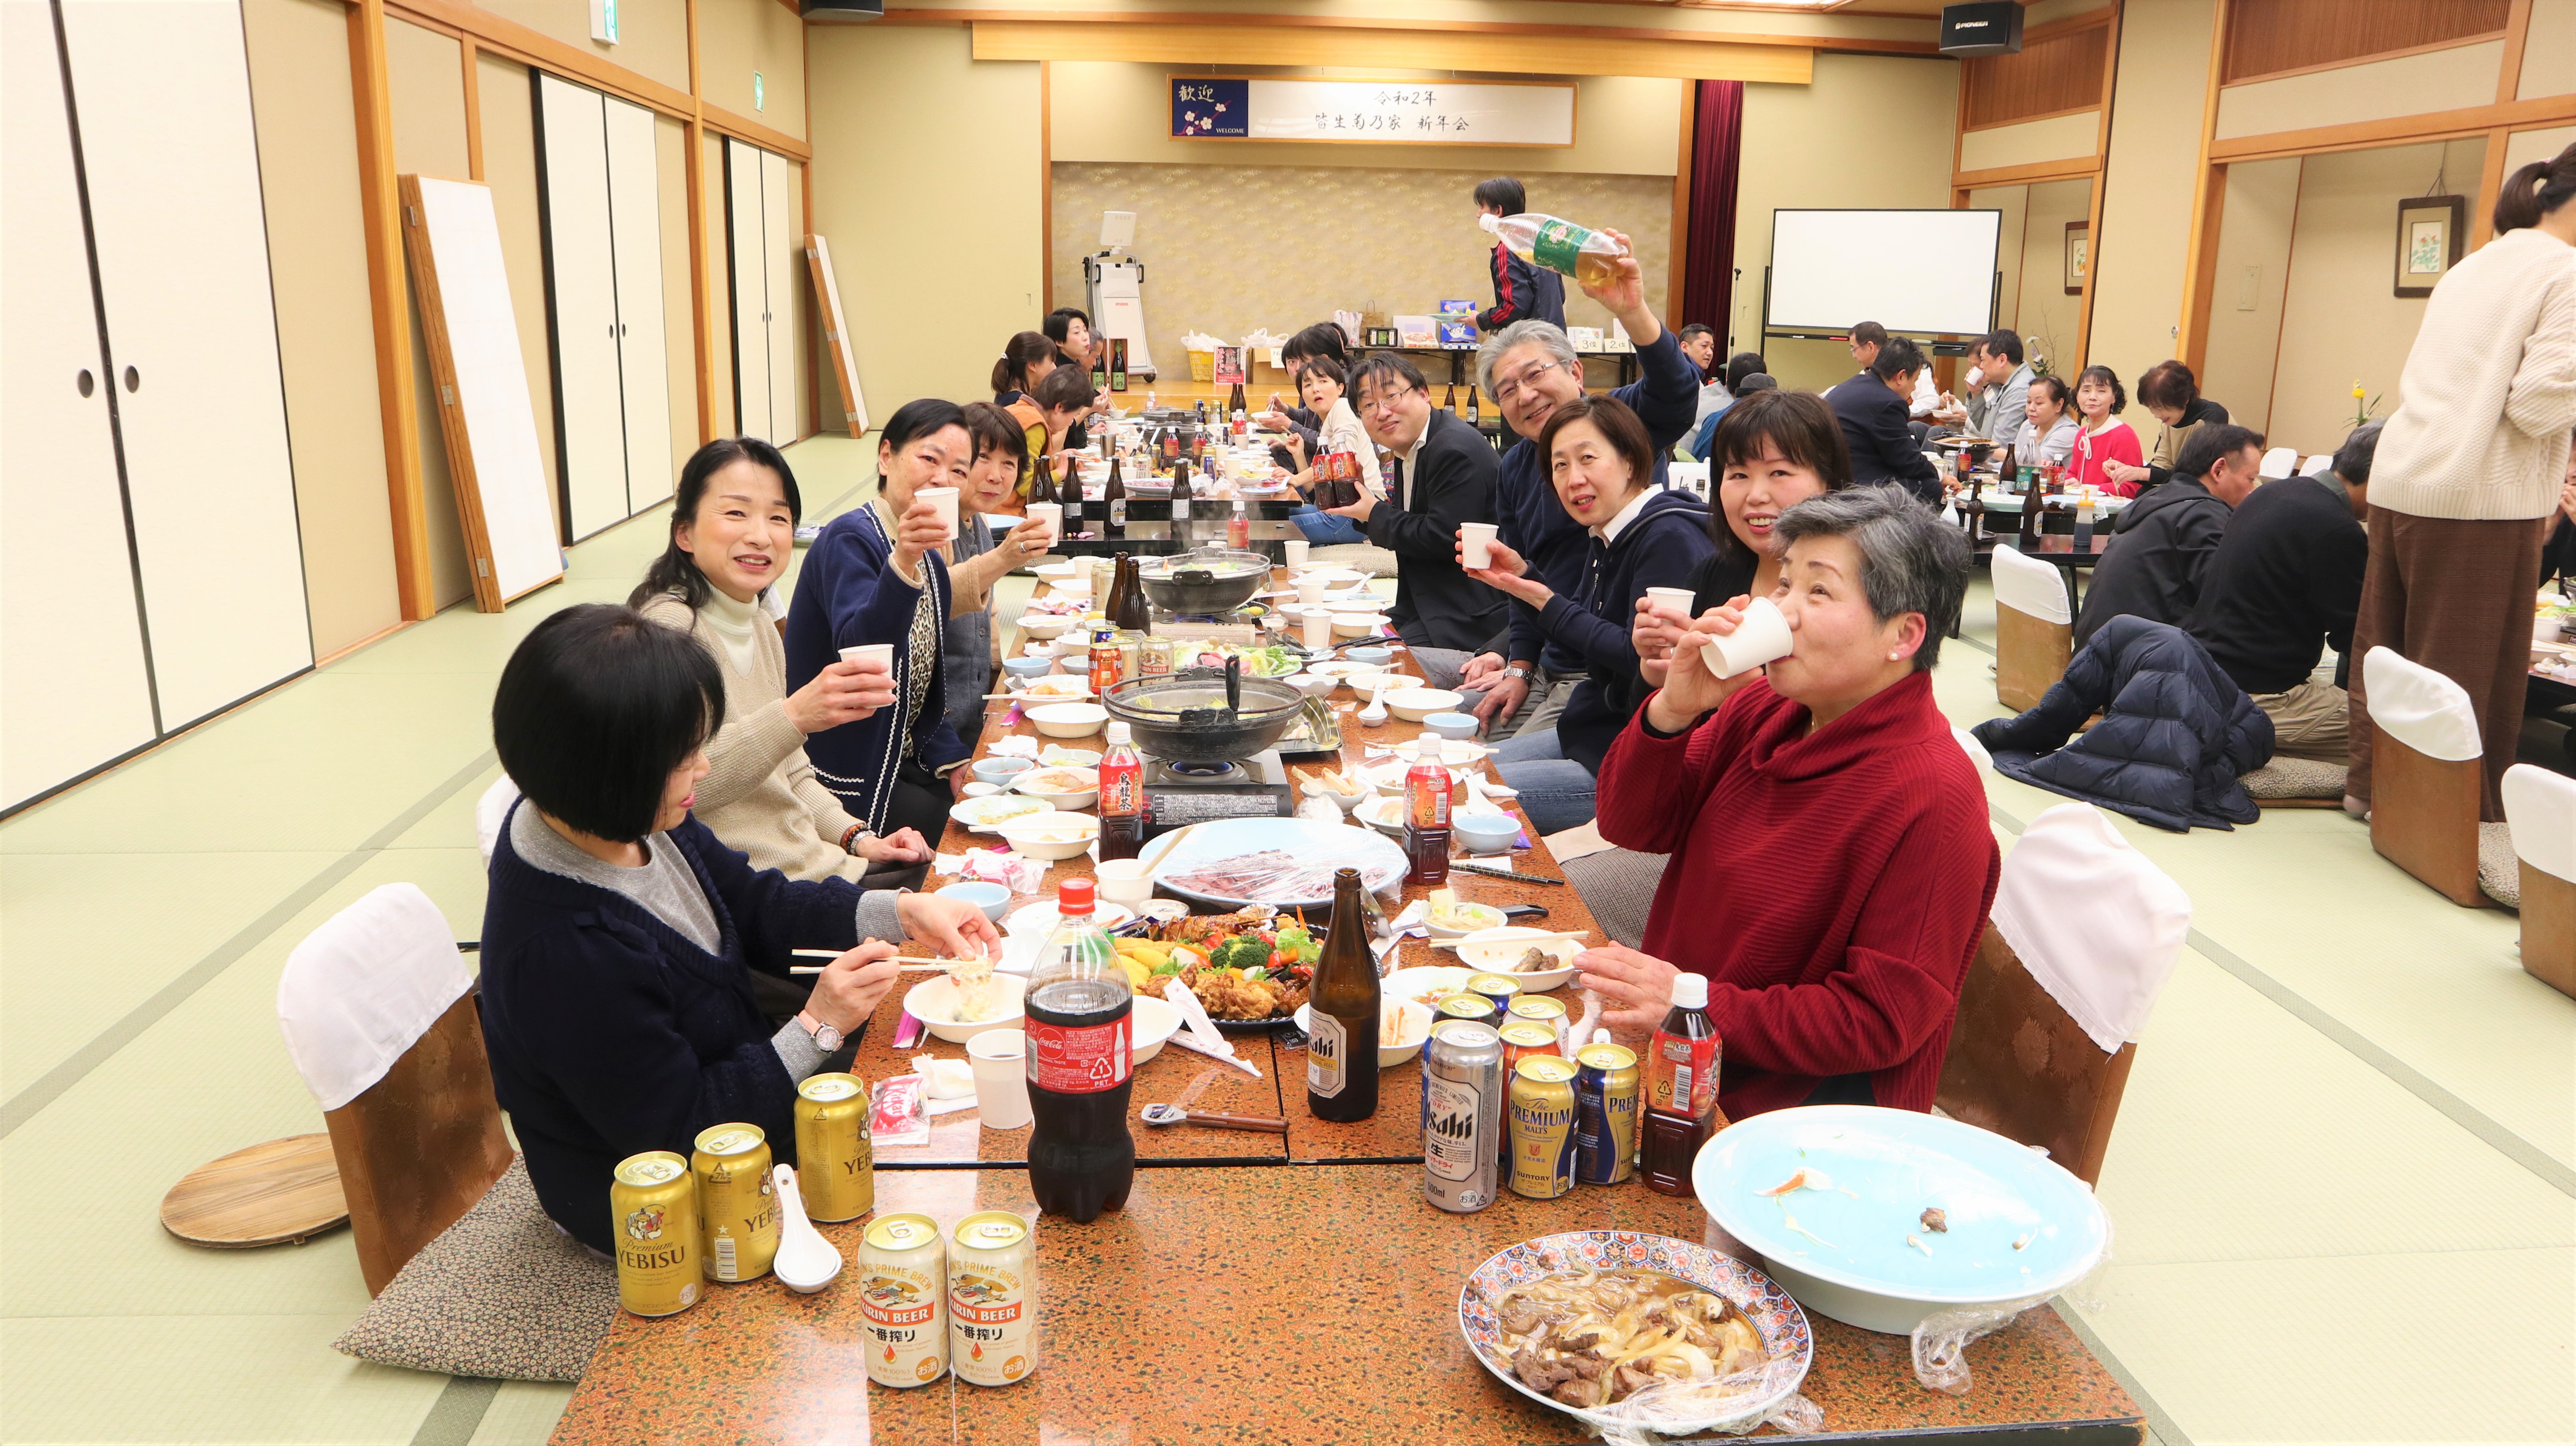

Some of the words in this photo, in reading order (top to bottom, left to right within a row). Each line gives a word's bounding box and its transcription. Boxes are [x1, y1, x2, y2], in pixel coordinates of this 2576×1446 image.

[1179, 84, 1215, 102] 歓迎
[1374, 91, 1437, 107] 令和2年
[1315, 112, 1401, 130] 皆生菊乃家
[1417, 115, 1469, 131] 新年会
[1582, 340, 1597, 349] 3位
[1610, 340, 1626, 349] 2位
[1119, 772, 1132, 811] 烏龍茶
[1038, 1055, 1054, 1063] ORIGINAL
[1099, 1064, 1103, 1074] 1
[1449, 1091, 1464, 1105] LIMITED
[1510, 1099, 1570, 1126] PREMIUM
[1427, 1102, 1473, 1140] sahi
[1524, 1125, 1547, 1135] MALT'S
[1431, 1142, 1443, 1159] 生
[1428, 1182, 1445, 1198] 500ml
[1459, 1194, 1477, 1203] お酒
[623, 1238, 673, 1252] Premium
[617, 1246, 685, 1269] YEBISU
[875, 1264, 908, 1278] PRIME
[910, 1271, 933, 1291] BREW
[964, 1261, 997, 1276] PRIME
[998, 1270, 1021, 1290] BREW
[862, 1300, 888, 1322] KIRIN
[893, 1309, 929, 1323] BEER
[981, 1307, 1016, 1321] BEER
[867, 1327, 915, 1343] 一番搾り
[955, 1324, 1002, 1340] 一番搾り
[917, 1360, 938, 1376] お酒
[1004, 1360, 1024, 1374] お酒
